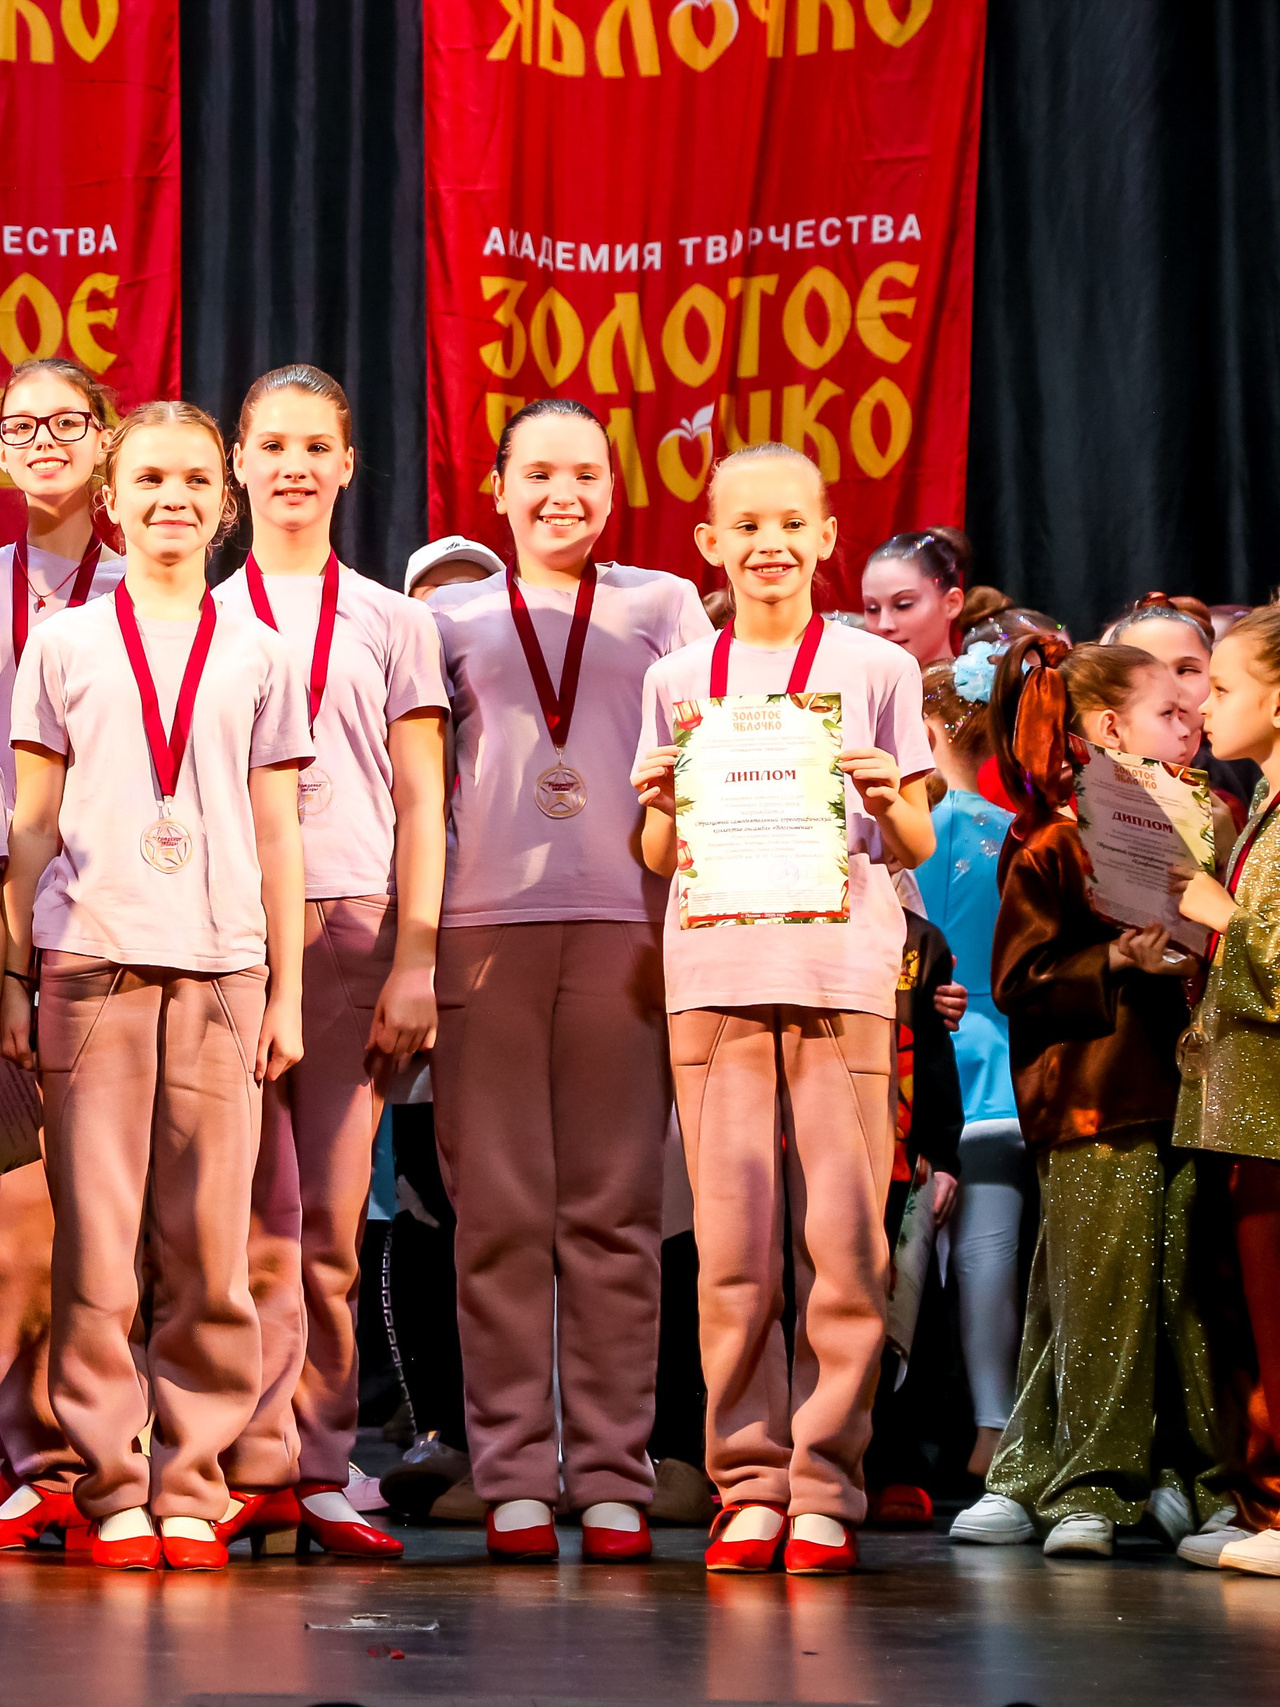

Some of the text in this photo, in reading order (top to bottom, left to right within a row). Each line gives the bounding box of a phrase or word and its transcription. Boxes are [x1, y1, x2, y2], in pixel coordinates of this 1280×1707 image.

[483, 213, 922, 273] АКАДЕМИЯ ТВОРЧЕСТВА
[479, 261, 920, 394] ЗОЛОТОЕ
[732, 710, 782, 722] ЗОЛОТОЕ
[732, 720, 782, 732] ЯБЛОЧКО
[724, 770, 797, 784] ДИПЛОМ
[1113, 764, 1156, 781] ЗОЛОТОЕ
[1112, 811, 1174, 834] ДИПЛОМ
